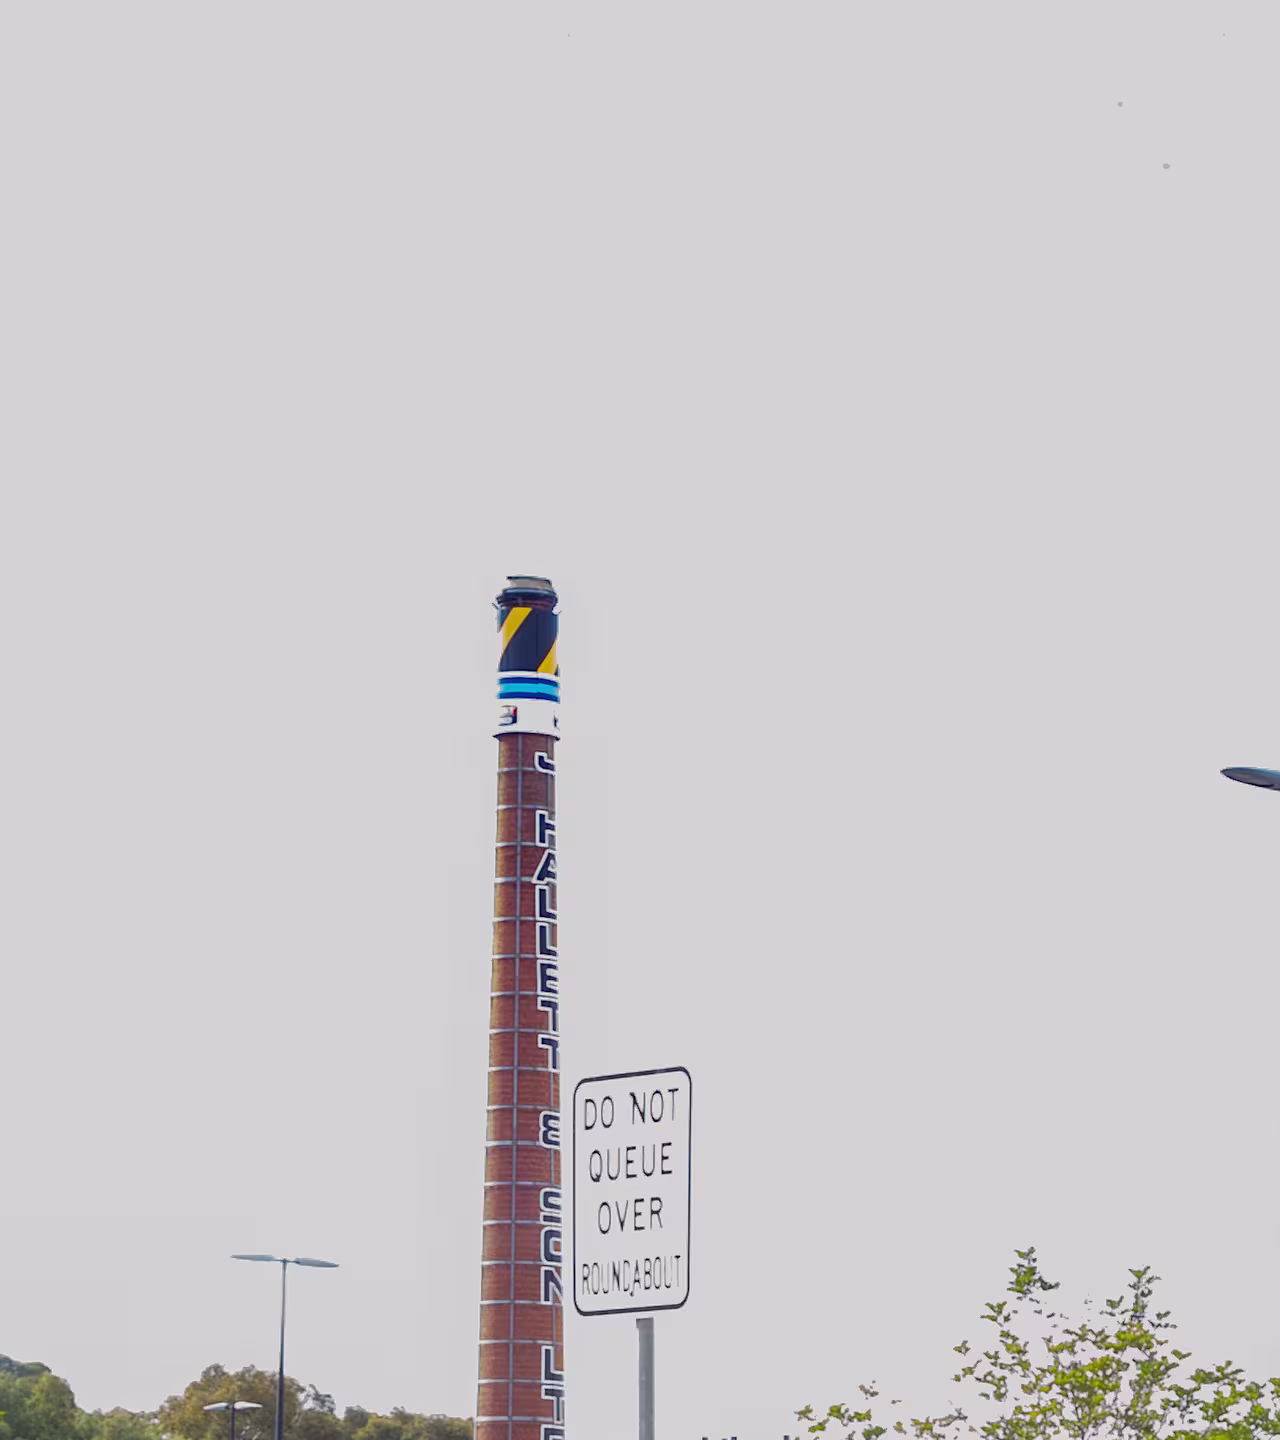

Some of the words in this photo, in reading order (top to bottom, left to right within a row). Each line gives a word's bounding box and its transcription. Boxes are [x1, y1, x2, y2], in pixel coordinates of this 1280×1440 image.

[584, 1096, 614, 1130] DO
[629, 1088, 679, 1125] NOT
[589, 1142, 673, 1183] QUEUE
[598, 1196, 664, 1235] OVER
[582, 1255, 682, 1297] ROUNDABOUT
